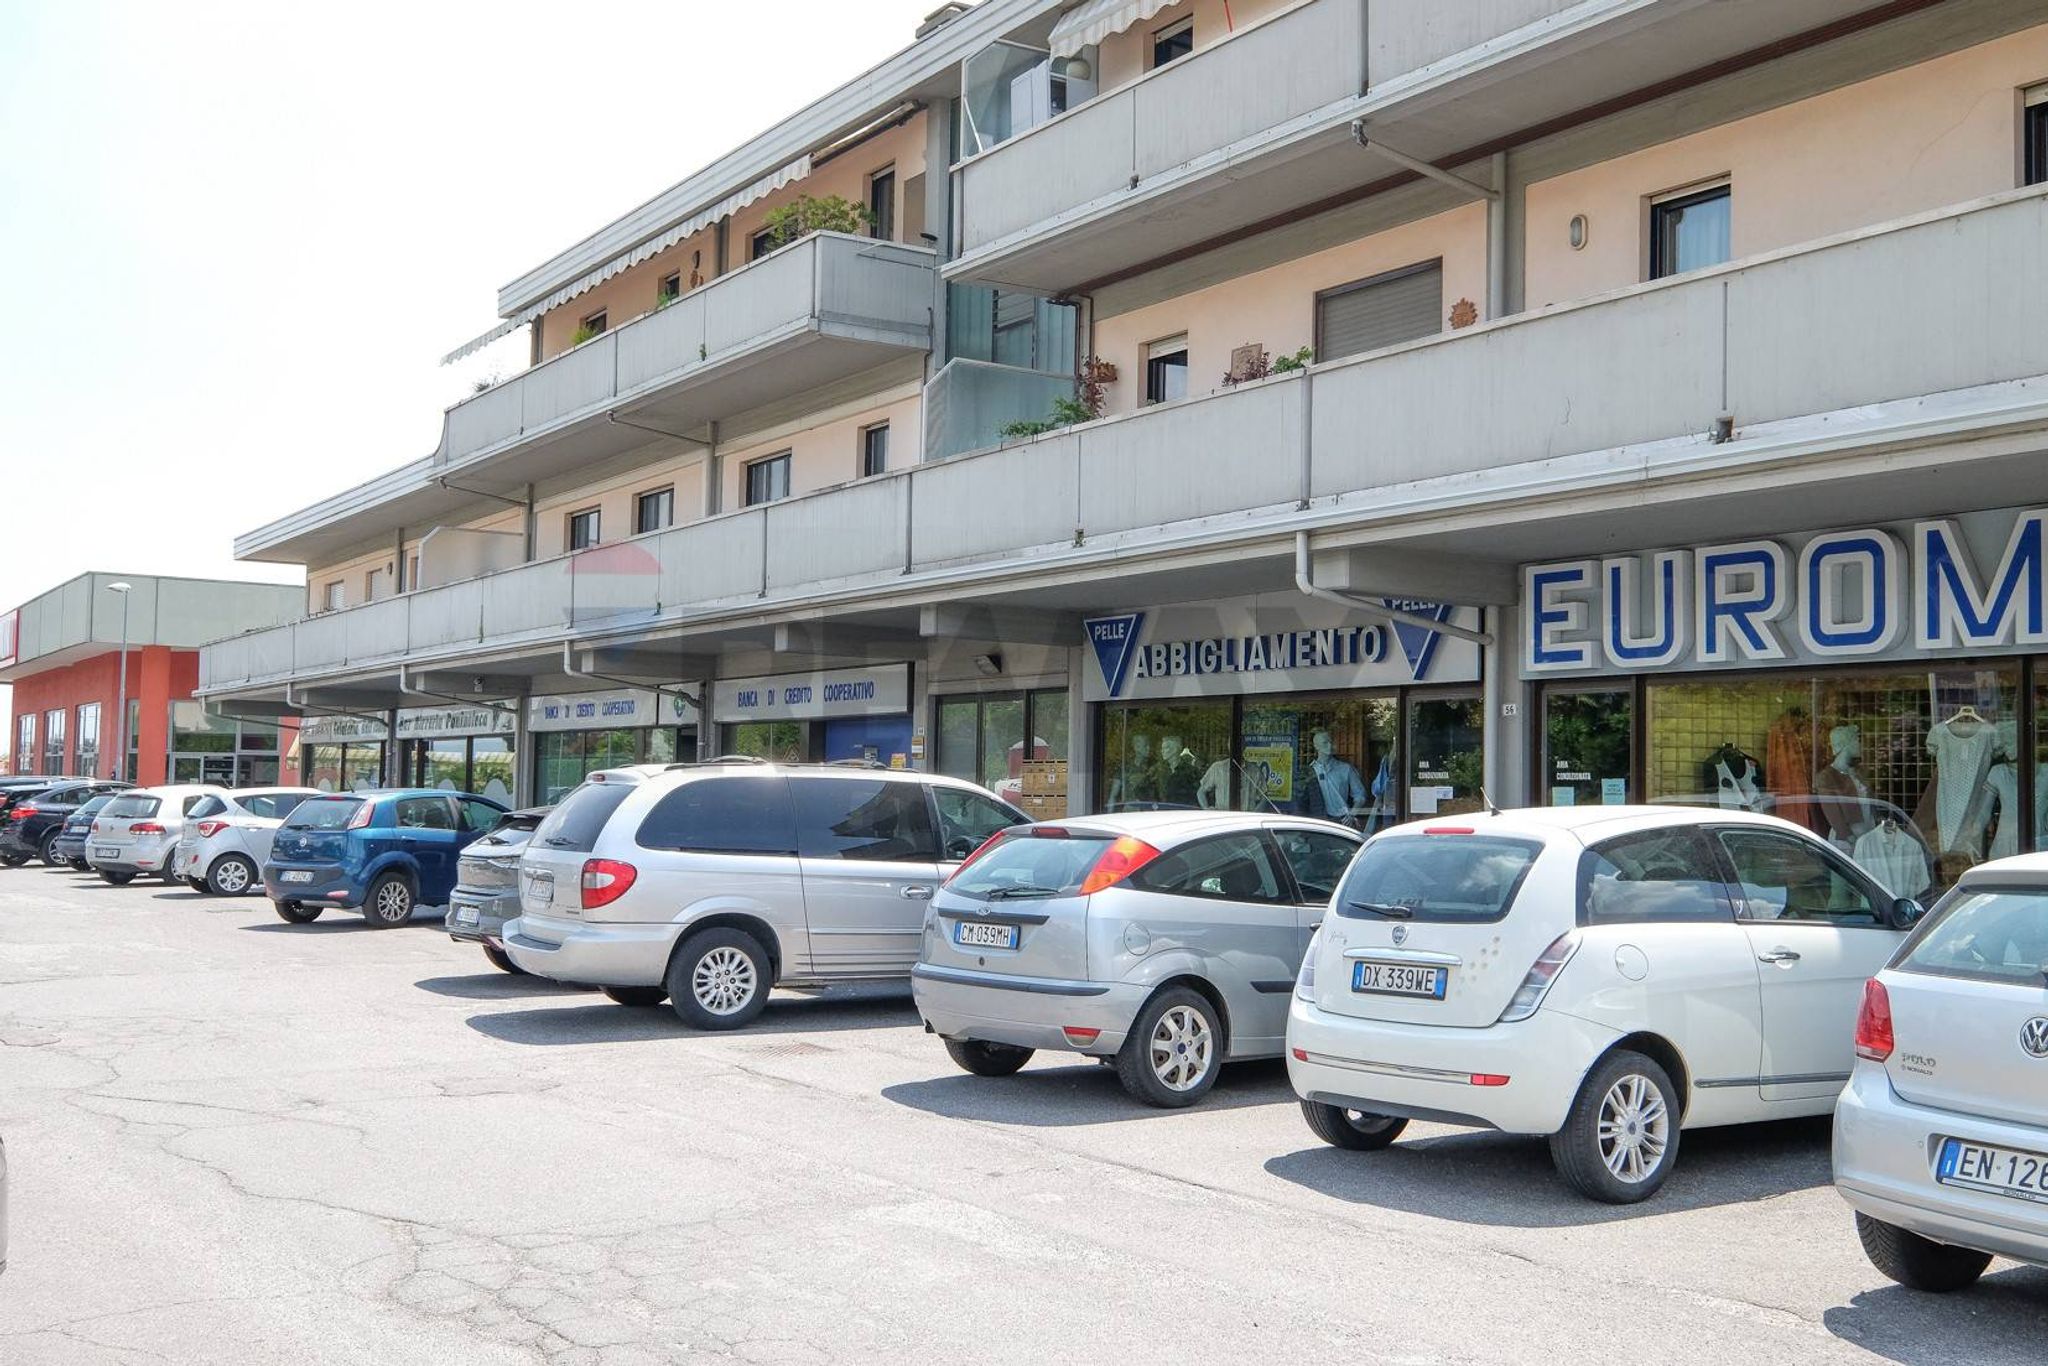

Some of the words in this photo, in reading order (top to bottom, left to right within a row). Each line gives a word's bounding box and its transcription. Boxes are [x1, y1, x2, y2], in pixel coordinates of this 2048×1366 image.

[1525, 508, 2048, 673] EUROM
[1094, 622, 1126, 641] PELLE
[1134, 624, 1386, 679] ABBIGLIAMENTO
[738, 690, 758, 708] BANCA
[768, 688, 775, 706] DI
[784, 686, 813, 704] CREDITO
[823, 681, 874, 702] COOPERATIVO
[544, 705, 559, 719] BANCA
[576, 703, 596, 718] CREDITO
[602, 700, 635, 716] COOPERATIVO
